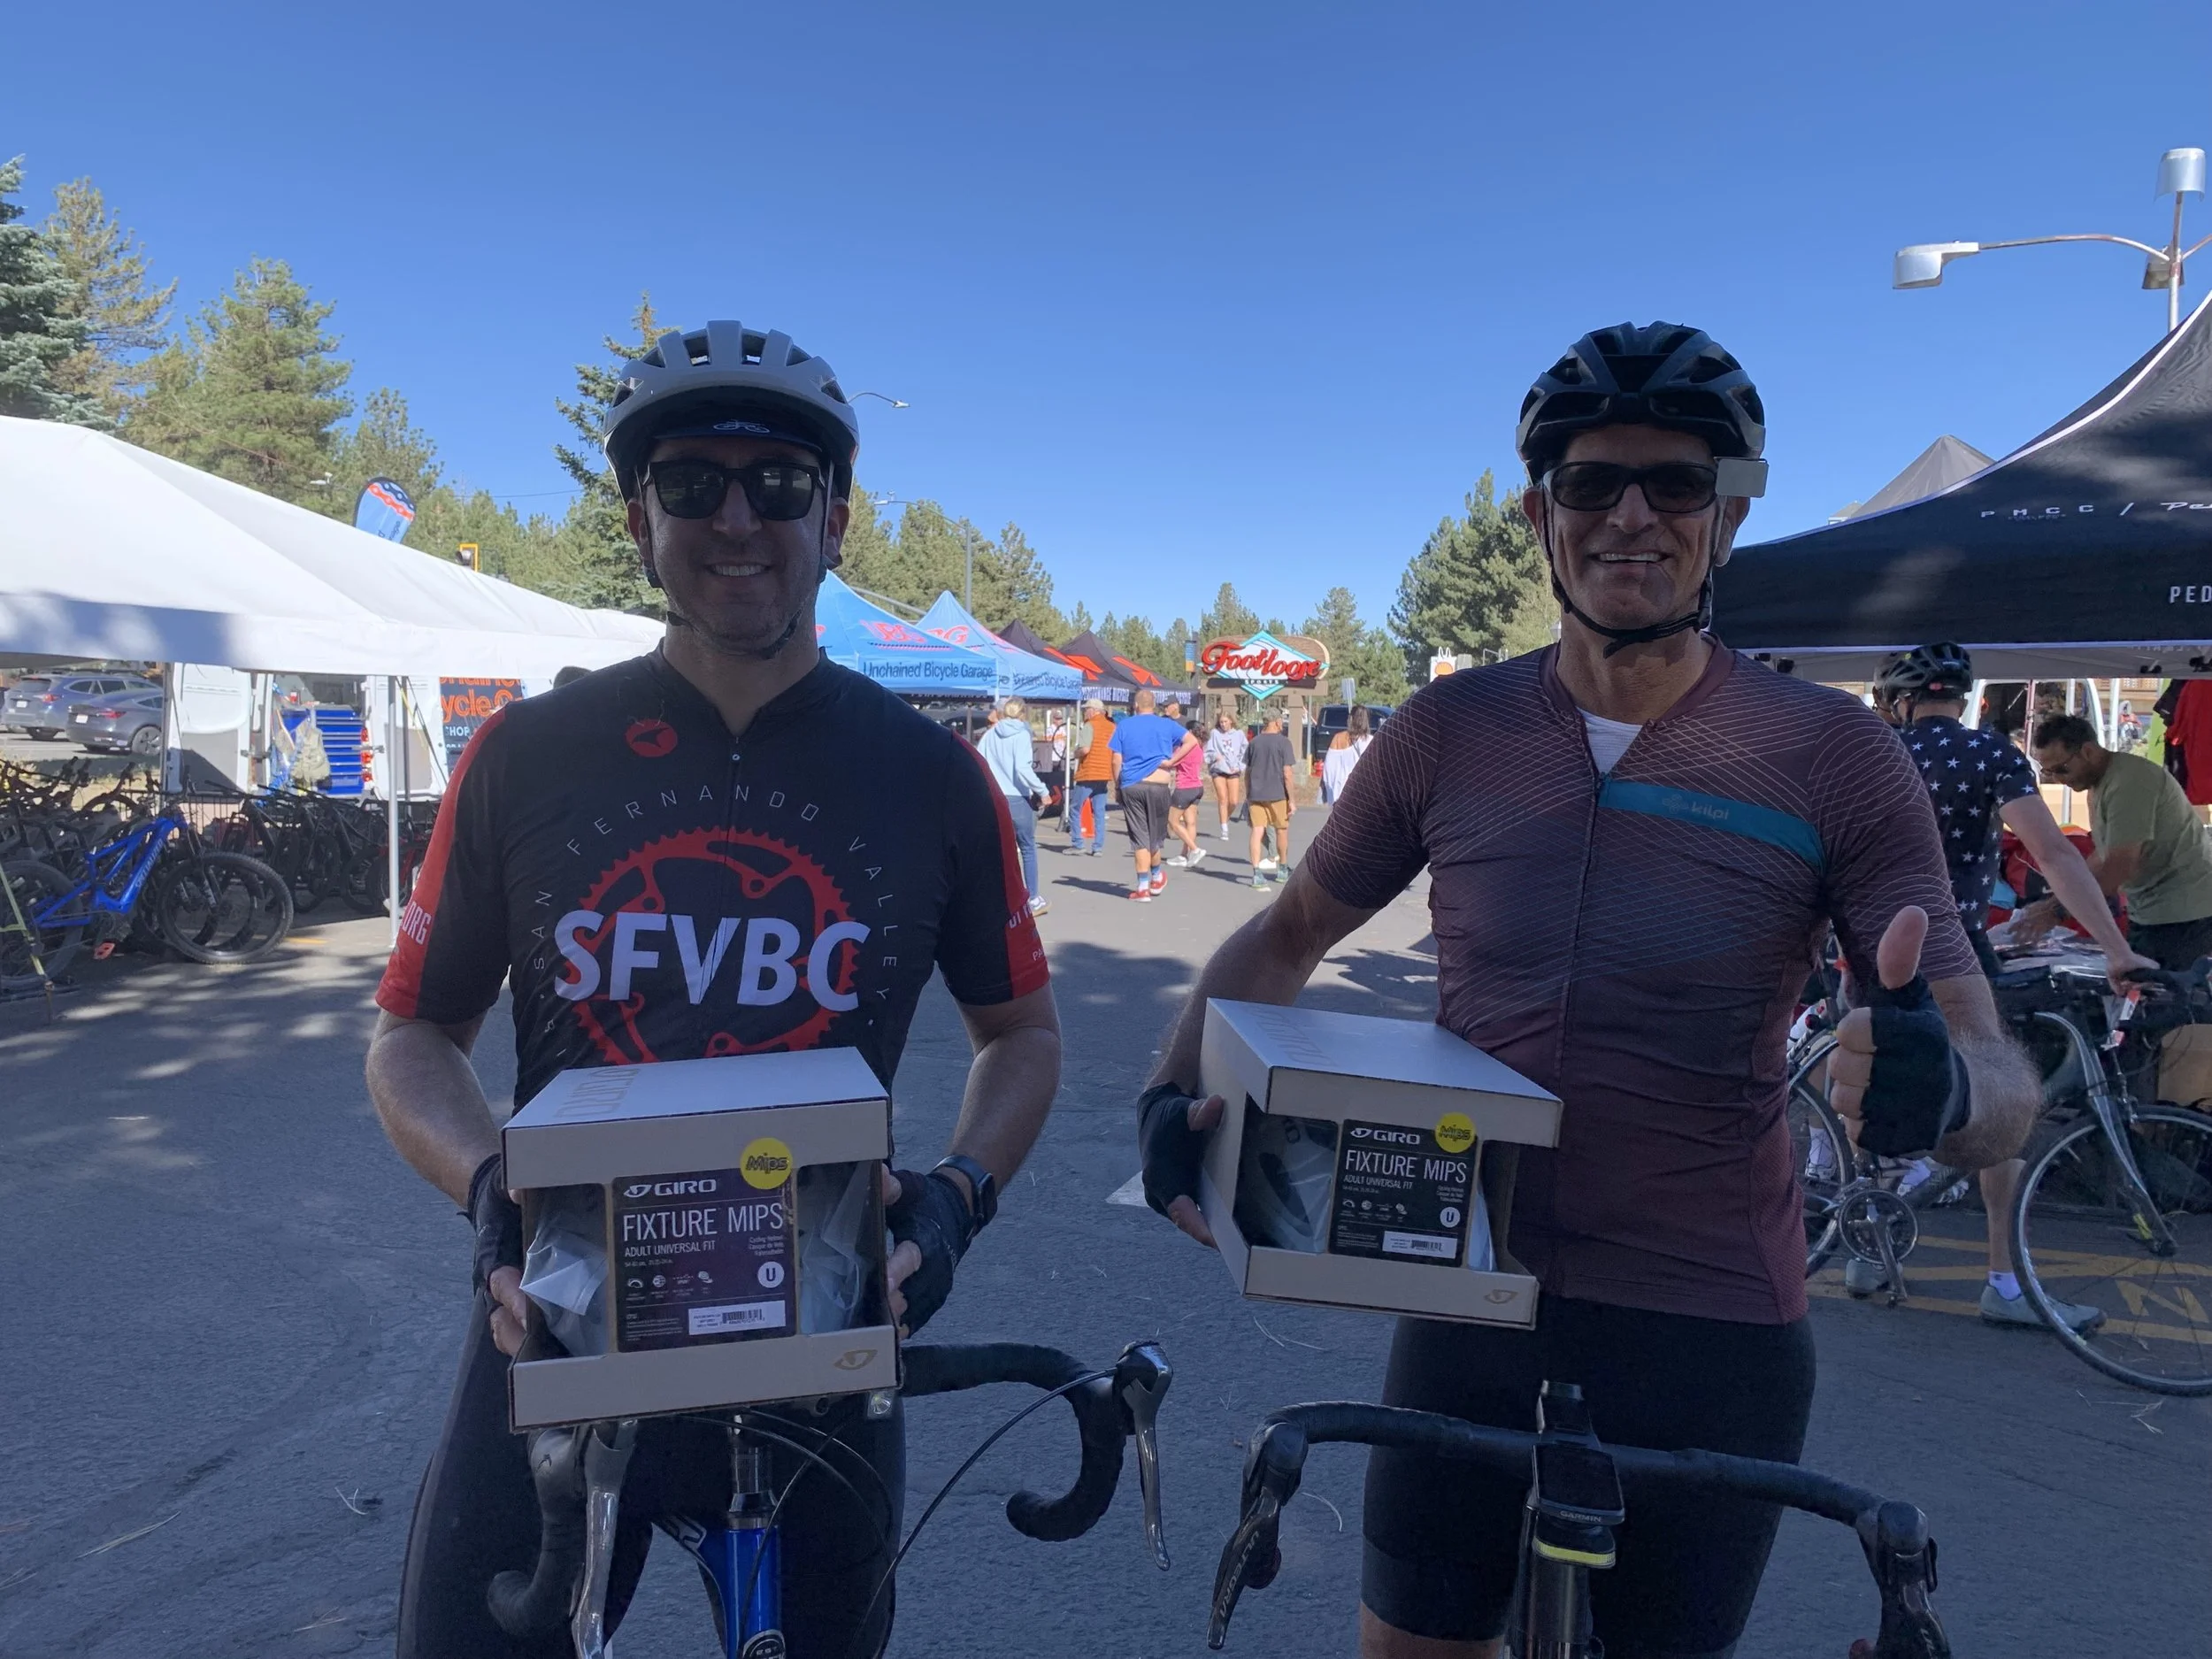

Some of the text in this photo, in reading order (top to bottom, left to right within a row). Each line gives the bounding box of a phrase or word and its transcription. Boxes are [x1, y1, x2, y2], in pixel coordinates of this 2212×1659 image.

[1202, 641, 1325, 680] Footloose
[864, 662, 921, 679] Unchained
[925, 662, 959, 680] Bicycle
[961, 663, 993, 681] Garage
[531, 785, 899, 1000] SAN FERNANDO VALLEY
[554, 910, 872, 1012] SFVBC
[1373, 1130, 1421, 1145] GIRO
[745, 1153, 789, 1174] Mips
[1345, 1149, 1467, 1184] FIXTURE MIPS
[655, 1179, 717, 1196] GIRO
[1343, 1174, 1414, 1190] ADULT UNIVERSAL FIT
[623, 1202, 784, 1242] FIXTURE MIPS
[1446, 1211, 1455, 1223] U
[625, 1240, 716, 1257] ADULT UNIVERSAL FIT
[765, 1268, 776, 1282] U
[1560, 1510, 1601, 1522] GARMIN
